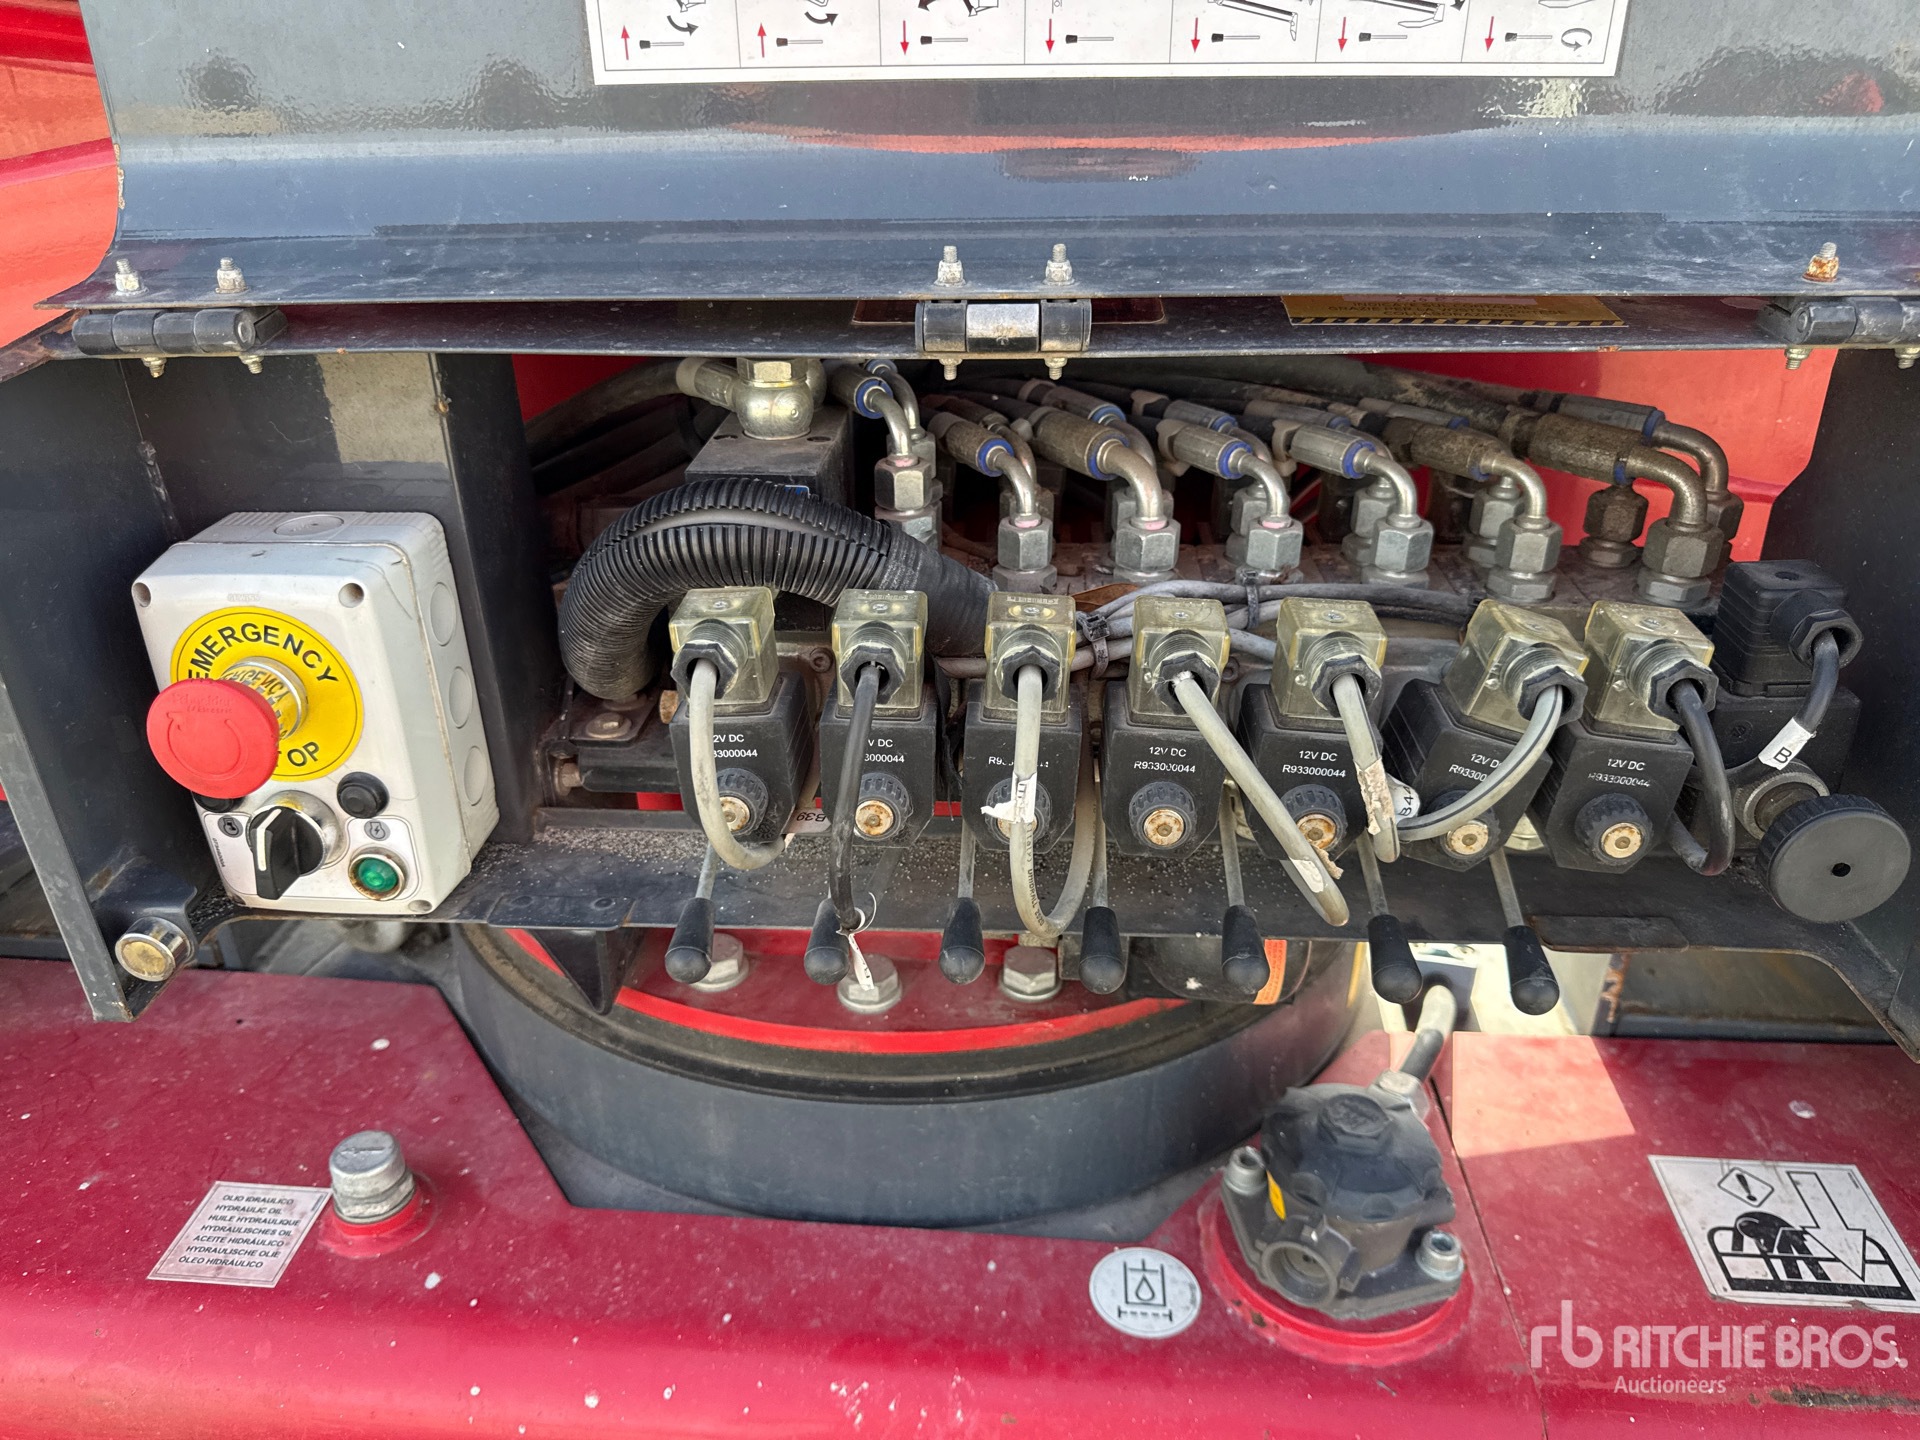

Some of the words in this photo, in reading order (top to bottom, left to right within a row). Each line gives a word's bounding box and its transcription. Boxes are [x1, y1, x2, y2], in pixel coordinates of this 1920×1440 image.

[188, 622, 339, 683] EMERGENCY
[713, 734, 726, 743] 2V
[728, 733, 745, 743] DC
[877, 739, 893, 748] DC
[713, 749, 758, 758] 33000044
[1149, 746, 1168, 756] 12V
[1170, 747, 1187, 757] DC
[1298, 750, 1319, 760] 12V
[1320, 752, 1338, 762] DC
[1773, 746, 1792, 764] B
[1470, 753, 1491, 765] 12V
[1490, 759, 1502, 769] D
[1607, 758, 1628, 768] 12V
[1627, 760, 1646, 771] DC
[1282, 764, 1346, 778] R933000044
[1448, 763, 1487, 782] R93300
[796, 812, 827, 823] B39
[222, 1194, 244, 1202] OLIO
[245, 1195, 294, 1204] IDRAULICO
[215, 1204, 266, 1214] HYDRAULIC
[268, 1207, 282, 1215] OIL
[208, 1215, 234, 1223] HUILE
[235, 1216, 301, 1227] HYDRAULIQUE
[200, 1224, 276, 1236] HYDRAULISCHES
[193, 1235, 225, 1244] ACEITE
[227, 1236, 284, 1247] HIDRÁULICO
[185, 1245, 258, 1257] HYDRAULISCHE
[258, 1250, 281, 1258] OLIE
[178, 1255, 205, 1264] ÓLEO
[206, 1257, 263, 1269] HIDRÁULICO
